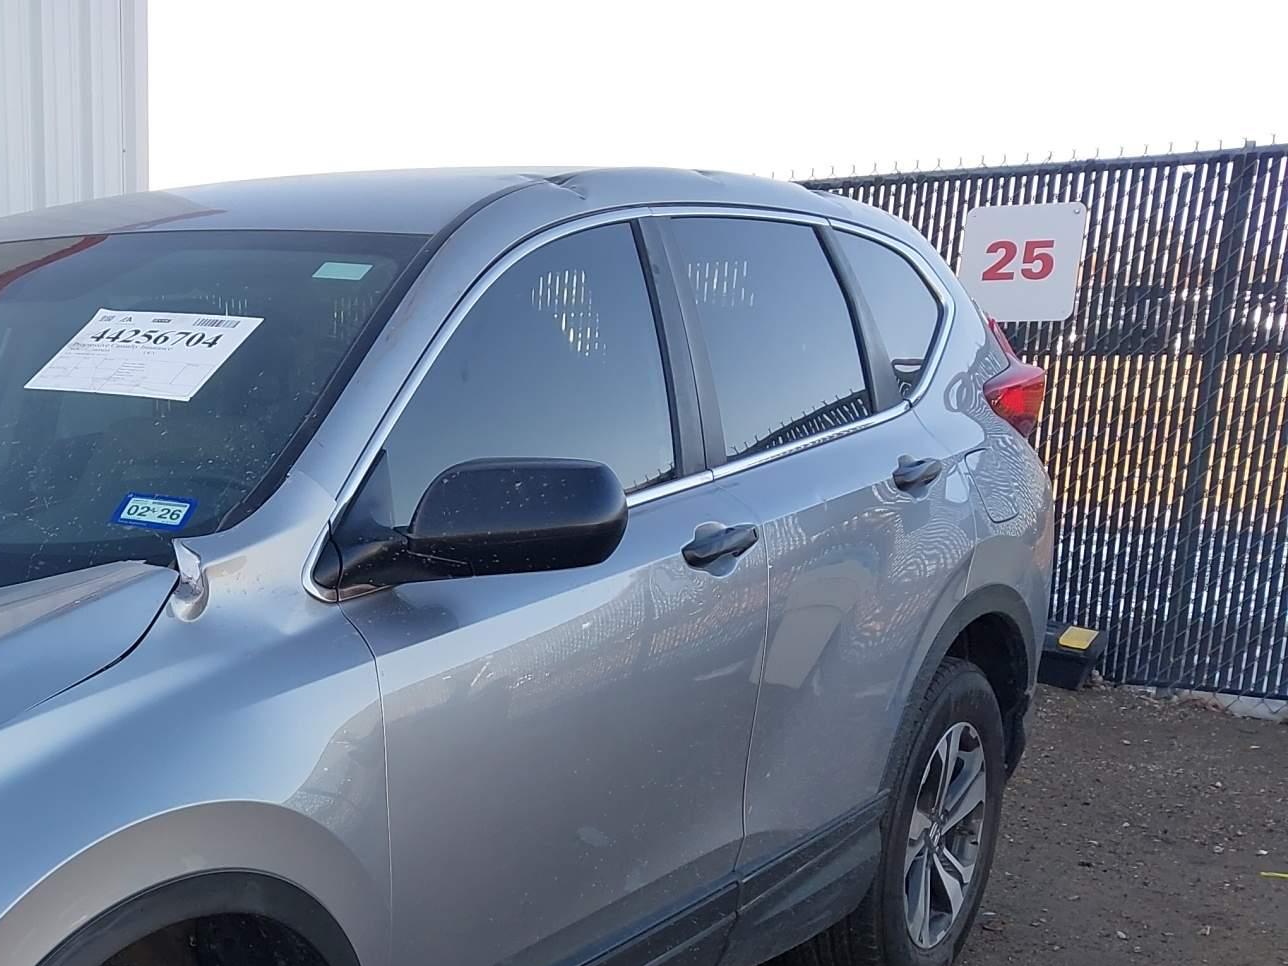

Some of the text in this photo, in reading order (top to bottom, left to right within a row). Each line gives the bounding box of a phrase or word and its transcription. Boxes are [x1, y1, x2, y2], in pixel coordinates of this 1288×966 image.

[981, 239, 1054, 281] 25
[90, 327, 225, 348] 44256704
[128, 505, 182, 521] 02 26
